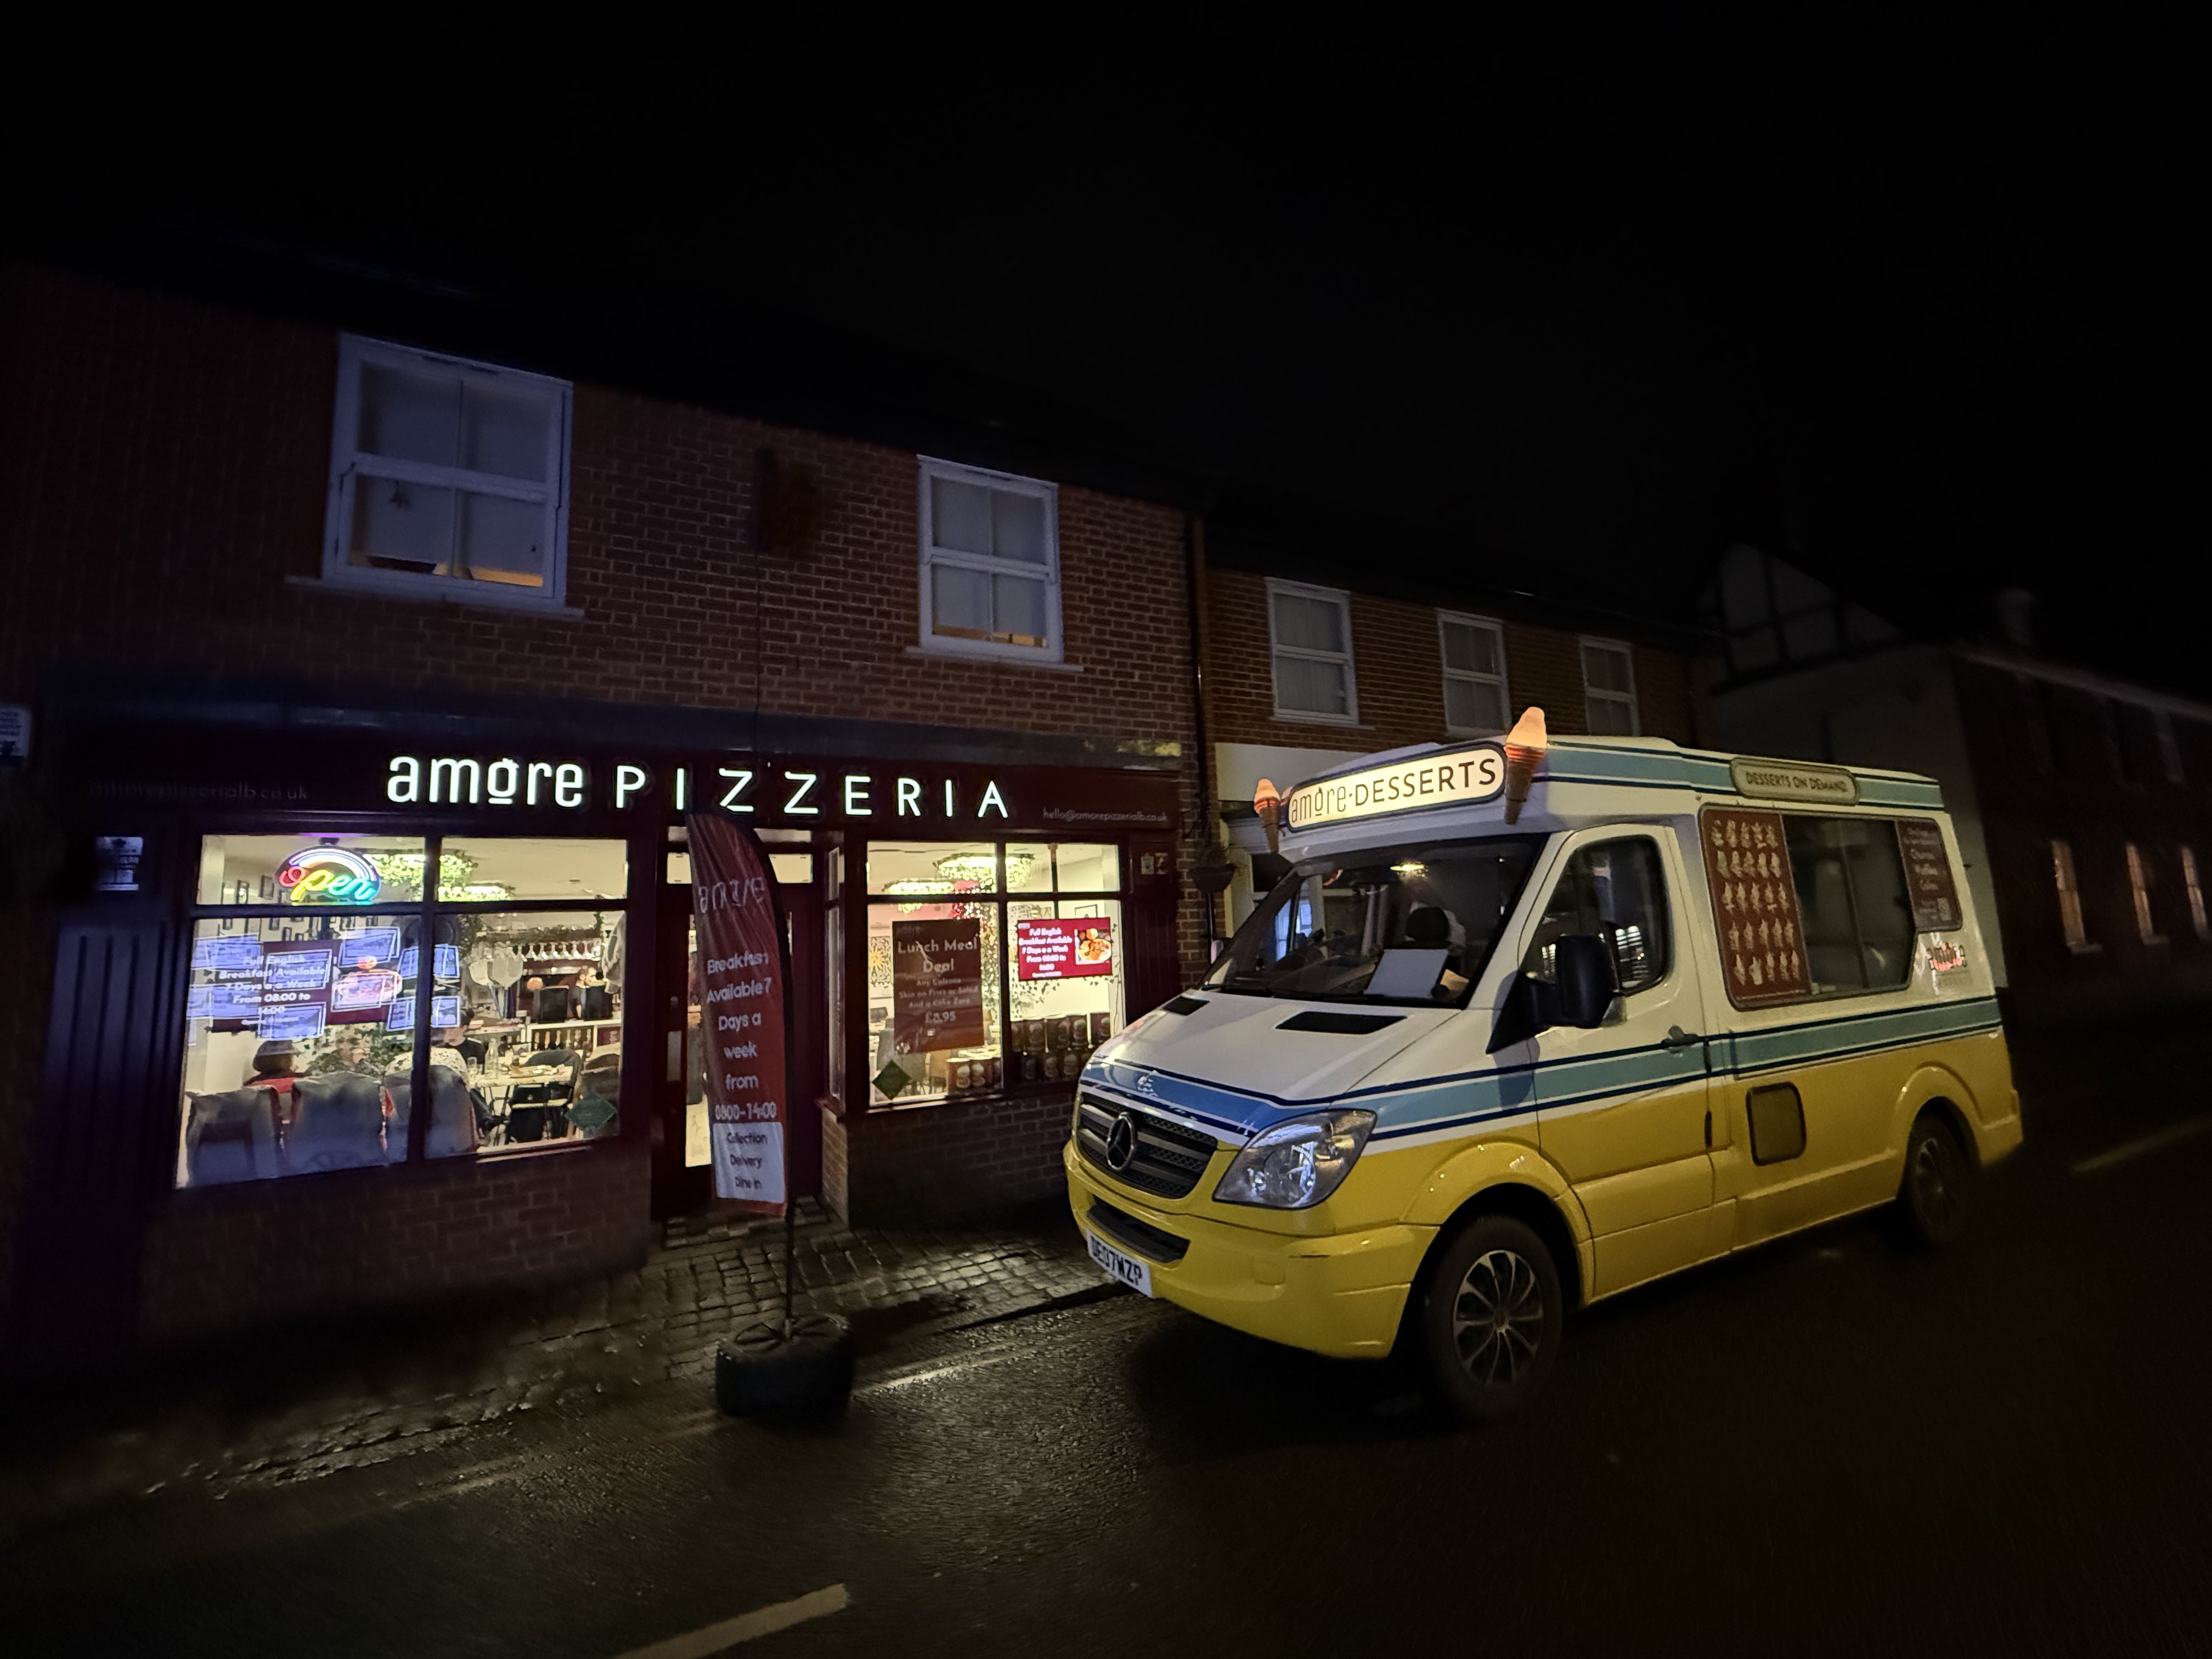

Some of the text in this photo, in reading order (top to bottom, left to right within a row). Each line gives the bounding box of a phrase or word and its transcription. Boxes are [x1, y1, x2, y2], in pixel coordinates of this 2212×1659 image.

[386, 755, 1009, 819] amore PIZZERIA
[1746, 772, 1791, 787] DESSERTS
[1792, 776, 1808, 788] ON
[1290, 758, 1496, 823] amore DESSERTS
[279, 866, 376, 902] open
[898, 937, 978, 954] Lunch Meal
[707, 951, 769, 974] Breakfast
[922, 958, 955, 973] Deal
[276, 966, 326, 977] Available
[233, 995, 262, 1004] From
[298, 992, 312, 1001] to
[707, 977, 772, 1003] Available 7
[718, 1012, 761, 1032] Days a
[723, 1041, 758, 1059] week
[725, 1074, 759, 1091] from
[727, 1132, 768, 1145] Collection
[730, 1154, 763, 1170] Delivery
[735, 1176, 752, 1188] Dine
